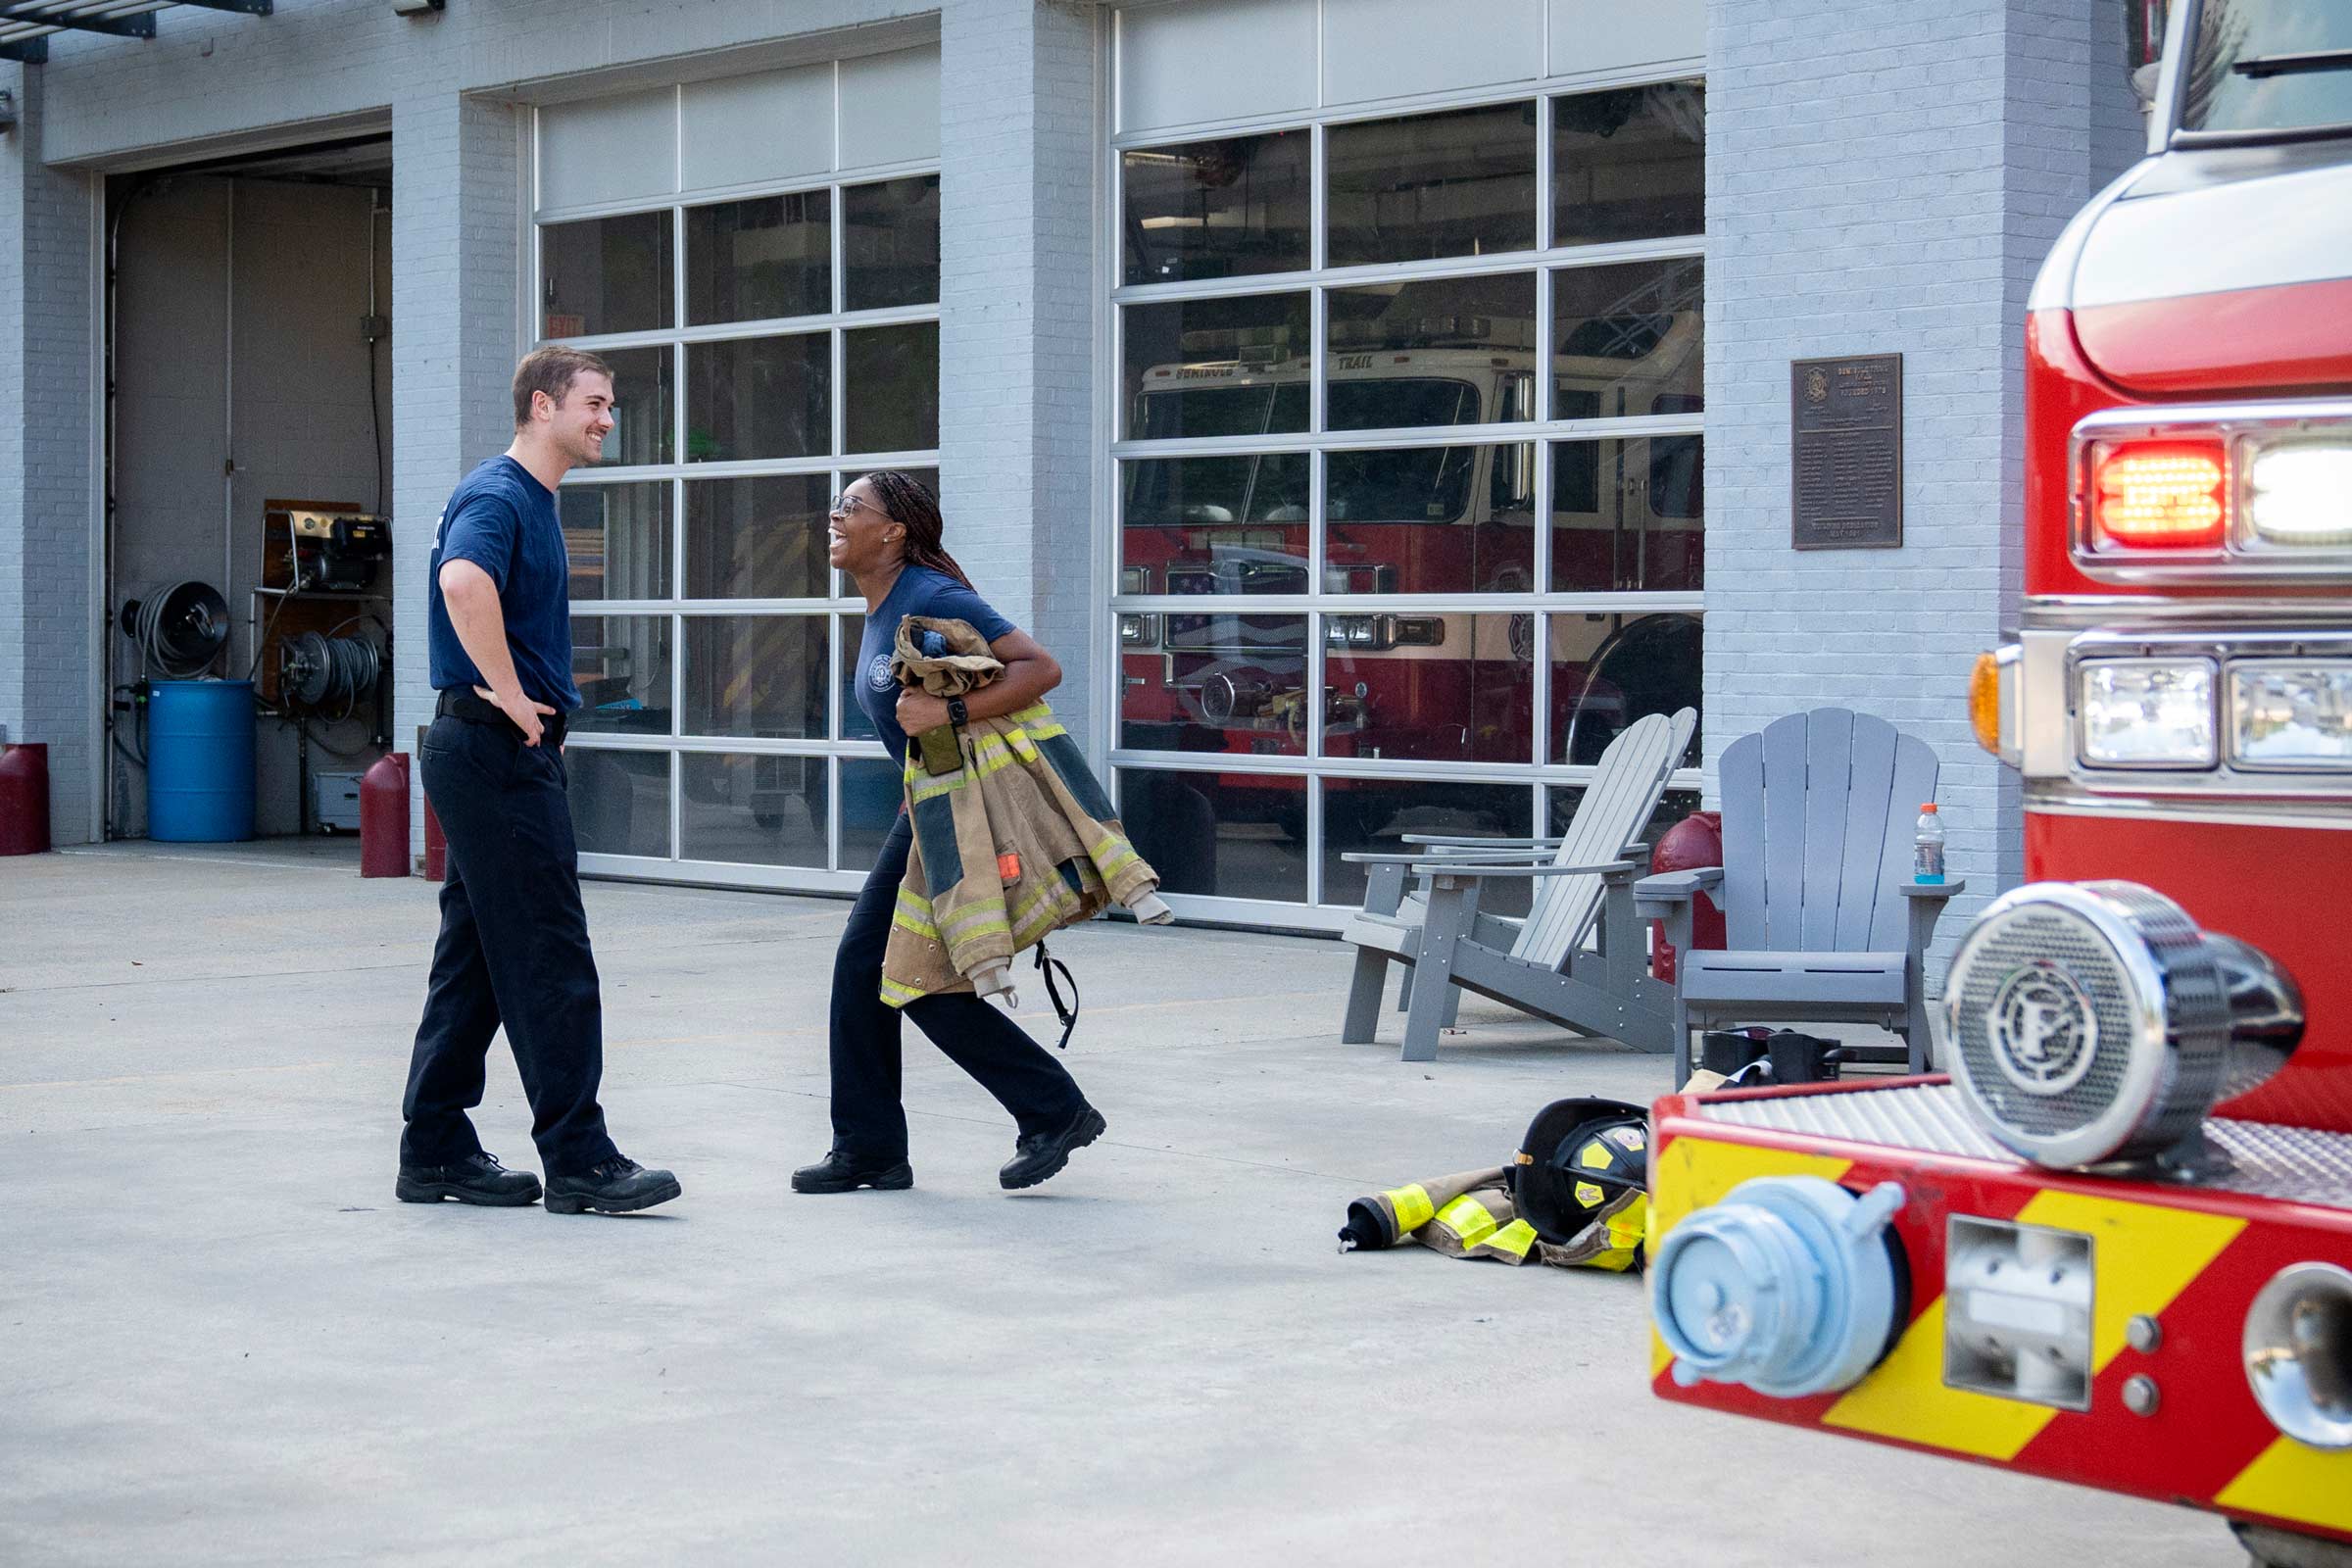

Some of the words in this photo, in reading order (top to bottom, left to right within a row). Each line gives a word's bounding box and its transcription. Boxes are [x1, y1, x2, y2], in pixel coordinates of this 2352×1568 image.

[549, 317, 579, 337] EXIT
[1176, 368, 1233, 379] SEMINOLE
[1339, 355, 1373, 369] TRAIL
